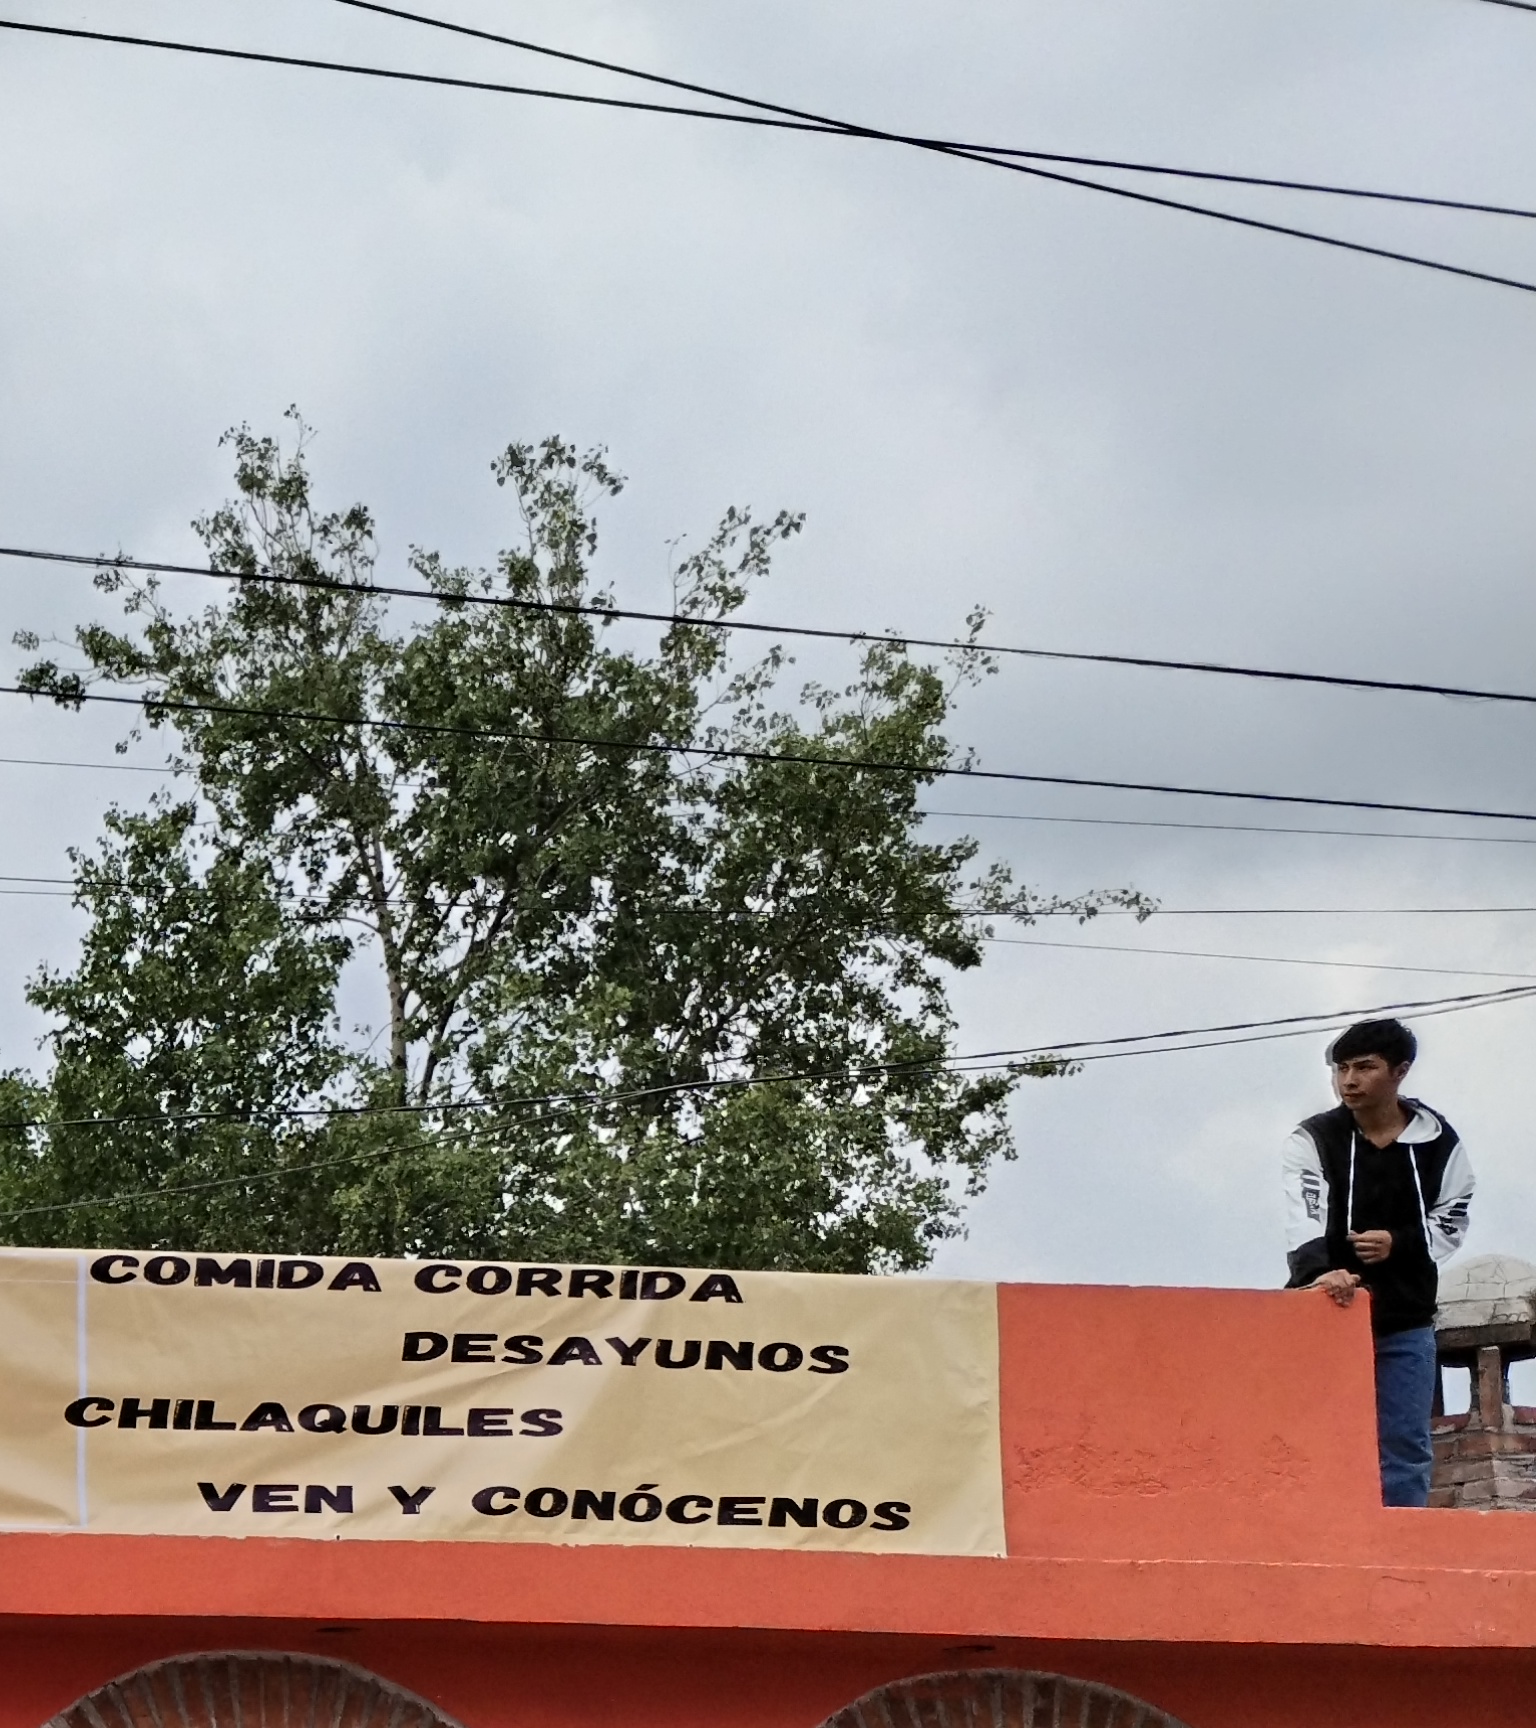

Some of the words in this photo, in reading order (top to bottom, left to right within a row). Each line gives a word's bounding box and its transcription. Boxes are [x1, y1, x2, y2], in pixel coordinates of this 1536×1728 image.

[89, 1253, 382, 1293] COMIDA
[414, 1264, 745, 1304] CORRIDA
[400, 1330, 850, 1376] DESAYUNOS
[63, 1395, 564, 1438] CHILAQUILES
[196, 1481, 355, 1515] VEN
[386, 1484, 437, 1516] Y
[470, 1481, 912, 1532] CONÓCENOS
